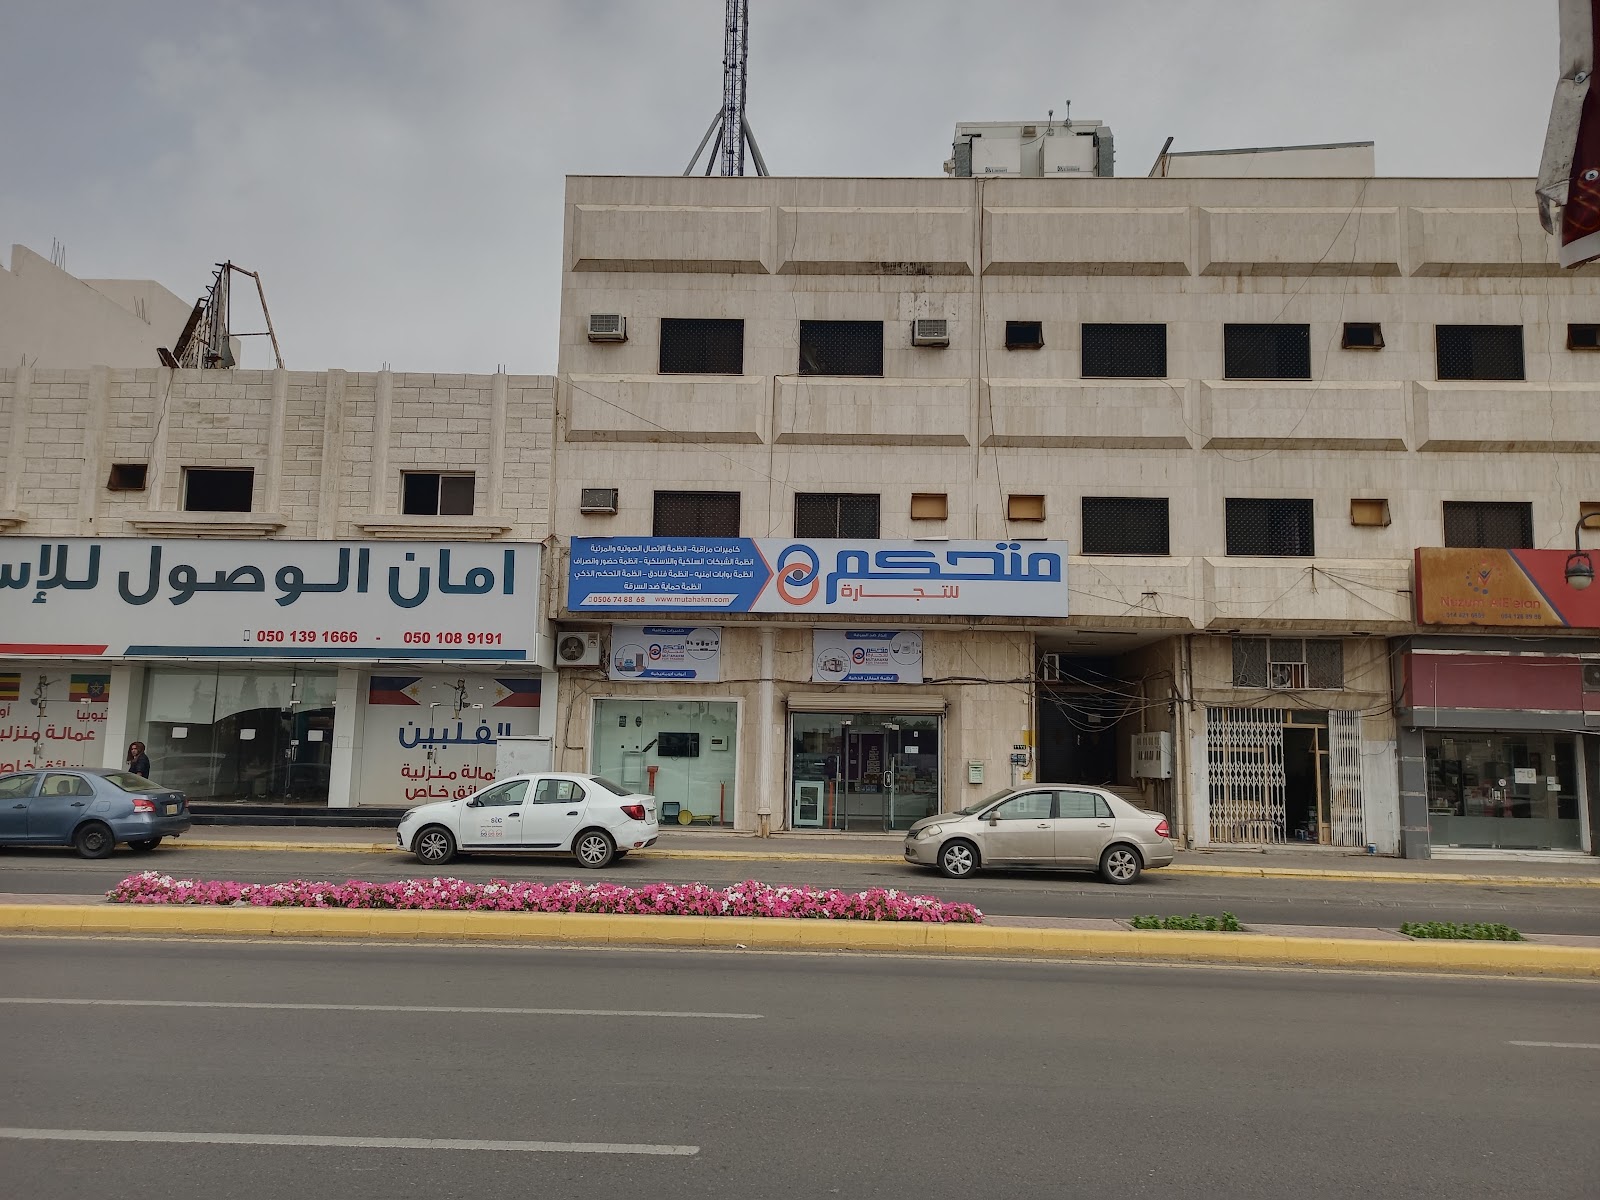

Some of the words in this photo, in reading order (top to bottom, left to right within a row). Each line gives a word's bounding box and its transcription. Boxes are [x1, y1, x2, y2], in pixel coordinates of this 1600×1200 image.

[118, 545, 370, 608] الوصول
[388, 549, 515, 609] امان
[826, 542, 1061, 604] متحكم
[623, 582, 648, 591] السرقة
[648, 582, 660, 590] ضد
[841, 584, 959, 602] للتجارة
[257, 630, 284, 643] 050
[289, 630, 317, 644] 139
[322, 631, 359, 644] 1666
[403, 632, 431, 645] 050
[436, 632, 463, 645] 108
[467, 632, 503, 646] 9191
[45, 724, 95, 742] عمالة
[401, 763, 458, 782] منزلية
[405, 785, 449, 801] خاص
[453, 785, 477, 800] ائق
